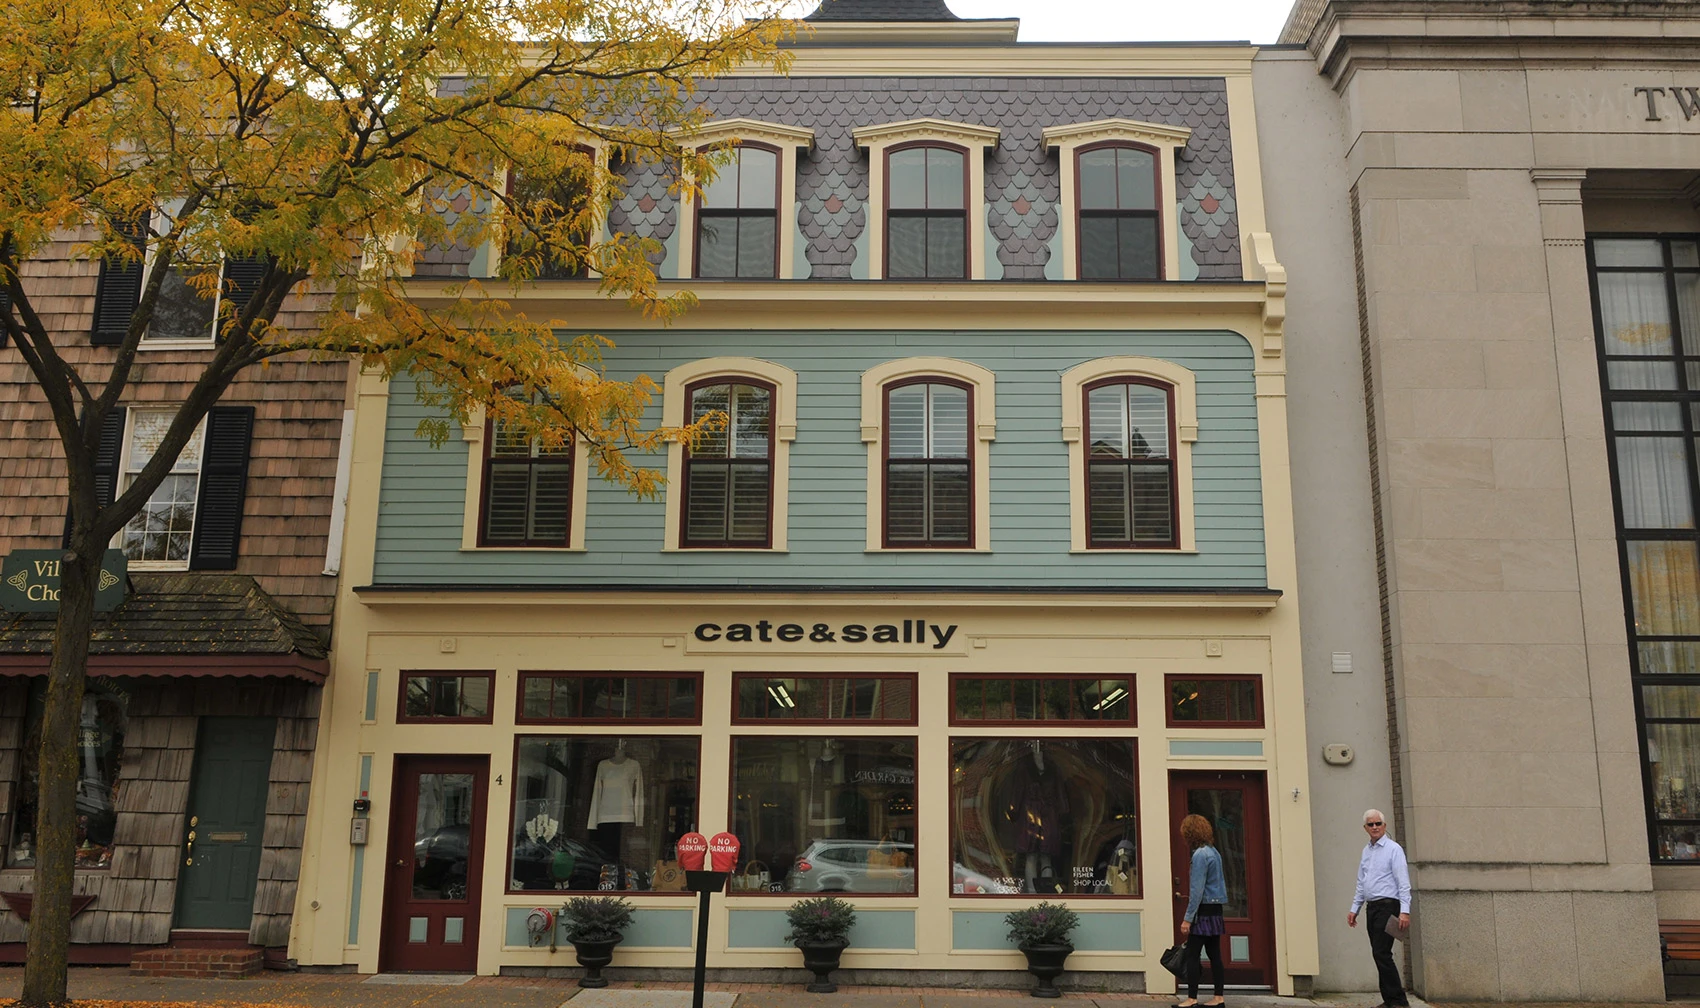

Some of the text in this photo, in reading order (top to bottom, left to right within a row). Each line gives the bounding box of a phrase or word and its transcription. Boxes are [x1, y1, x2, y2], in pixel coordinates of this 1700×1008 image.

[694, 619, 958, 649] cate&sally
[495, 774, 503, 786] 4
[710, 845, 737, 853] PARKING
